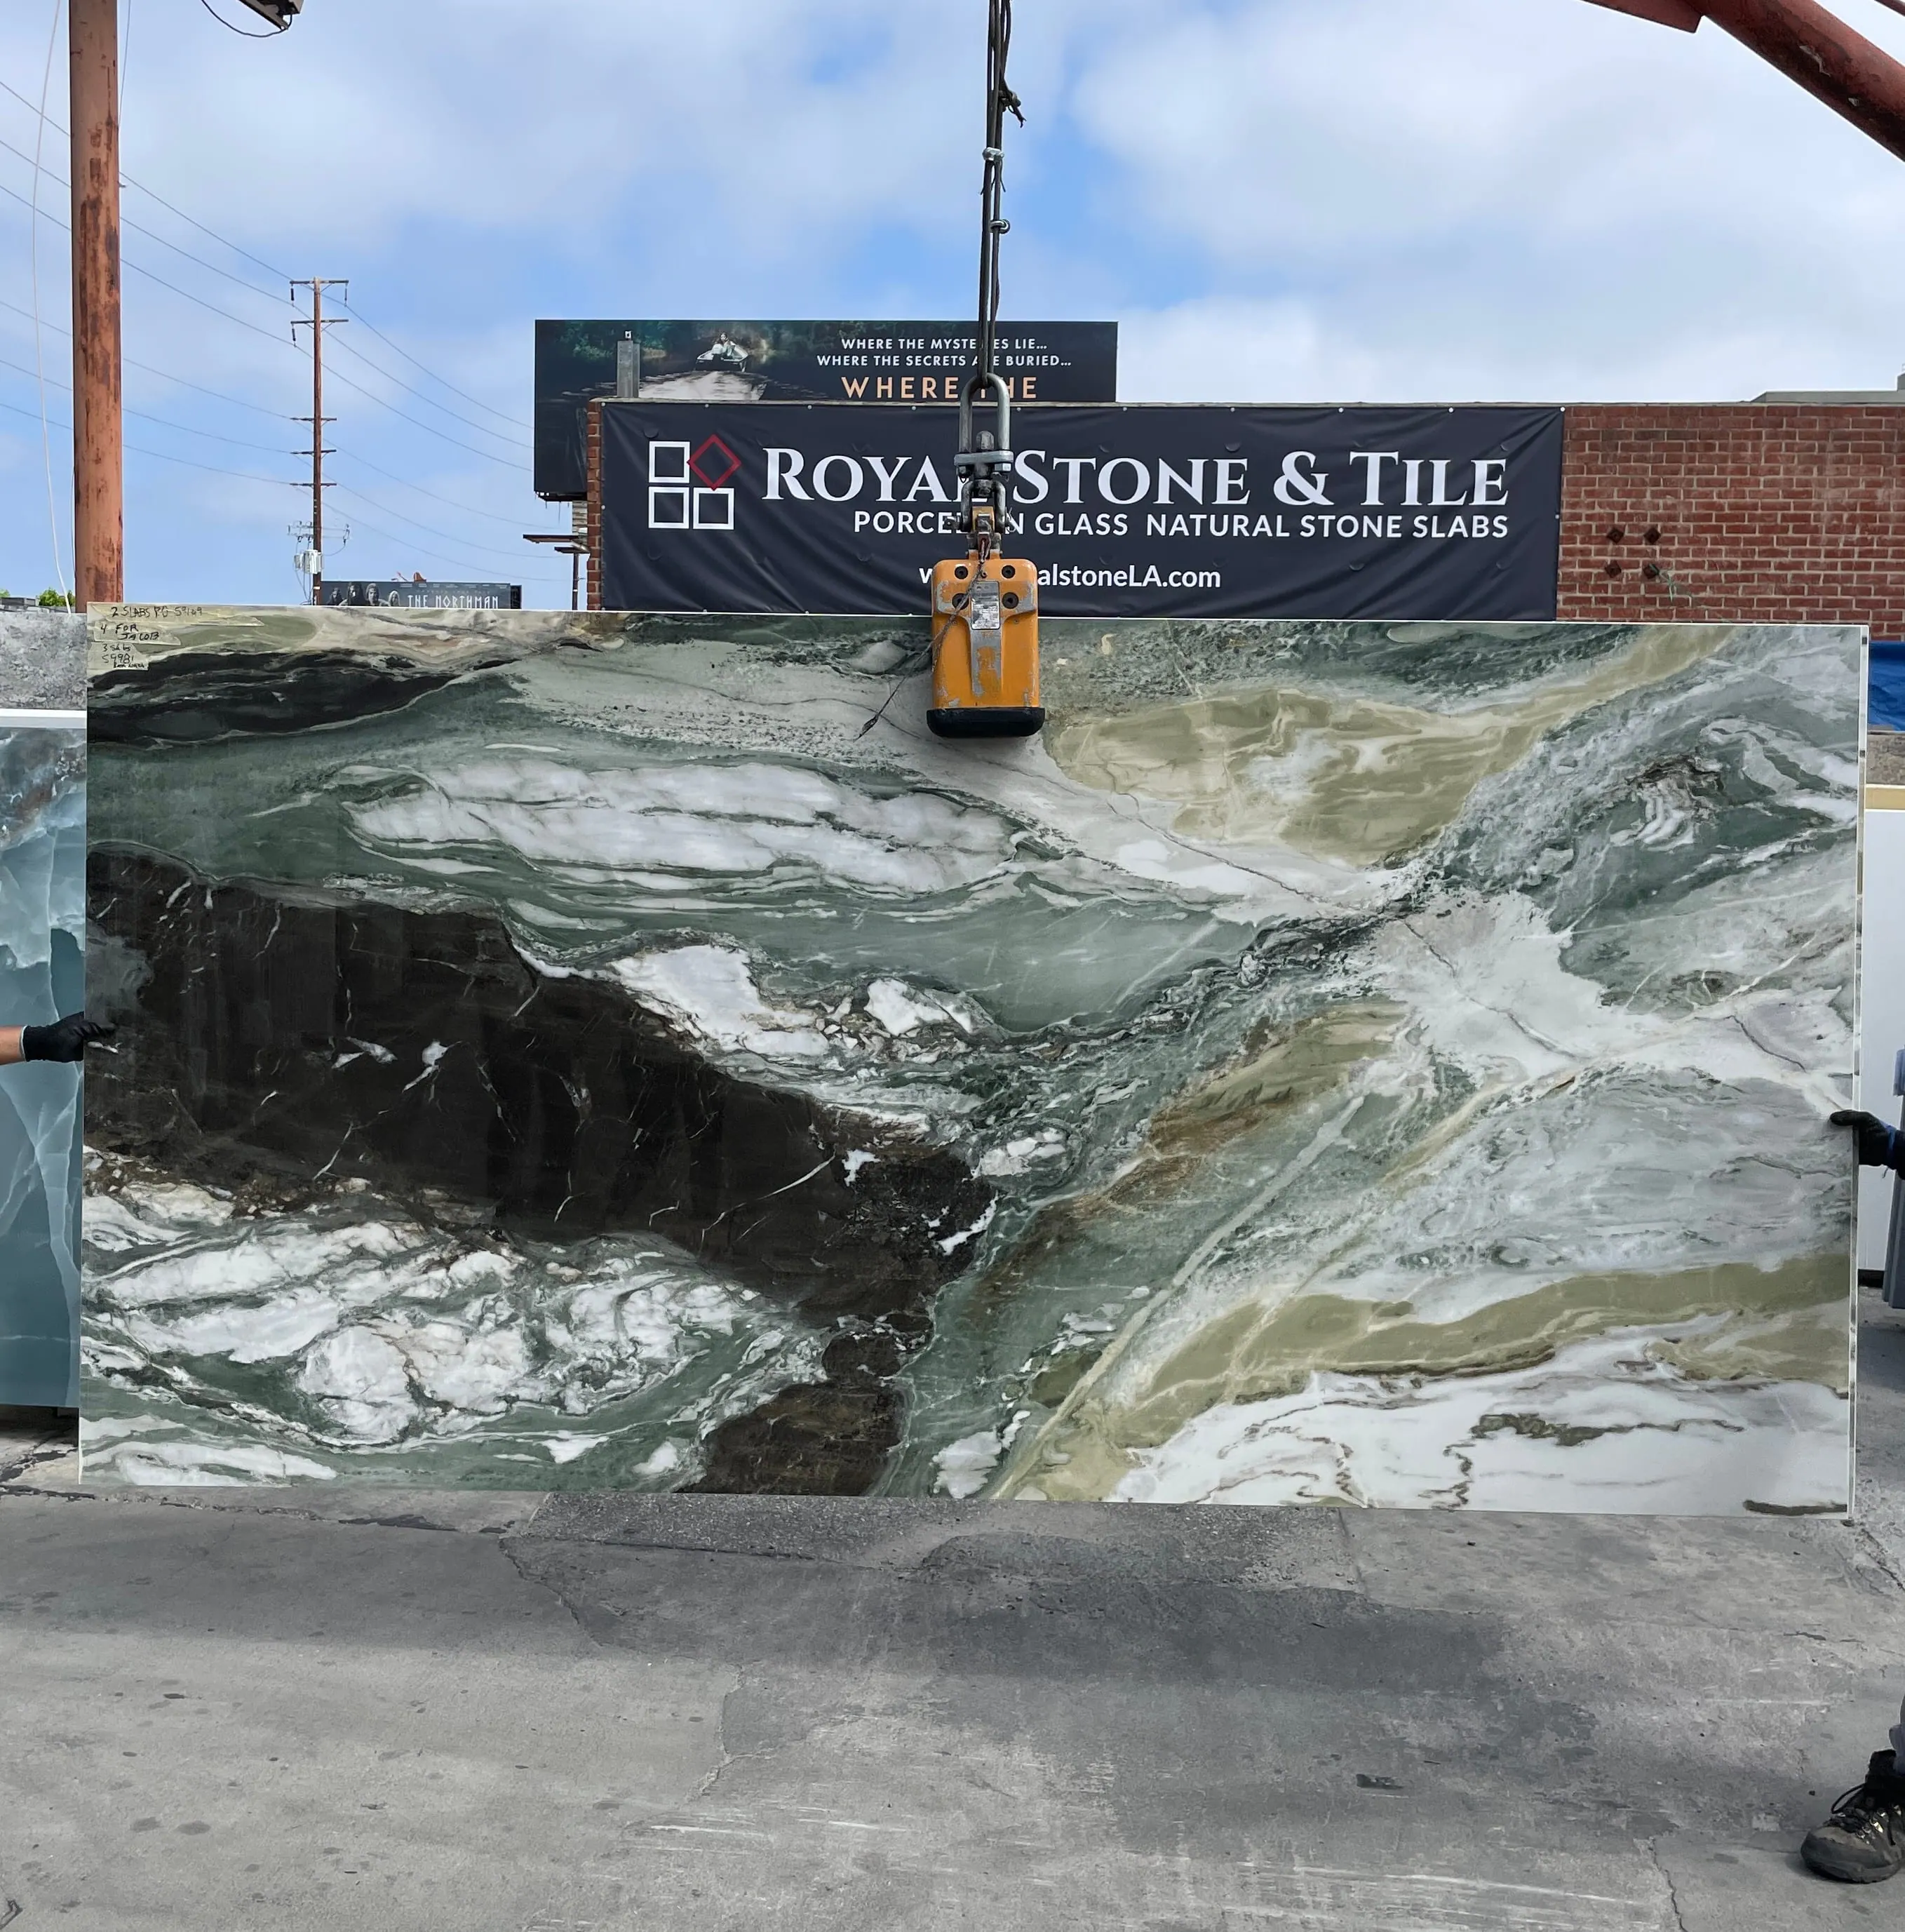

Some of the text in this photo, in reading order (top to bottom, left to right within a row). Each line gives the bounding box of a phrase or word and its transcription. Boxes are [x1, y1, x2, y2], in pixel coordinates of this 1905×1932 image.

[842, 338, 892, 349] WHERE
[899, 338, 925, 349] THE
[931, 338, 1009, 349] MYSTEES
[817, 355, 868, 366] WHERE
[875, 355, 900, 366] THE
[906, 355, 966, 366] SECRETS
[972, 355, 999, 366] AE
[842, 377, 960, 398] WHERE
[1013, 450, 1251, 505] STONE
[1273, 450, 1334, 506] &
[1349, 451, 1509, 506] TILE
[854, 511, 1509, 538] PORCEN GLASS NATURAL STONE SLABS
[408, 594, 498, 608] THE NORTHMAN
[100, 623, 139, 634] 4 FOR
[119, 631, 160, 640] JACOB
[102, 643, 108, 652] 3
